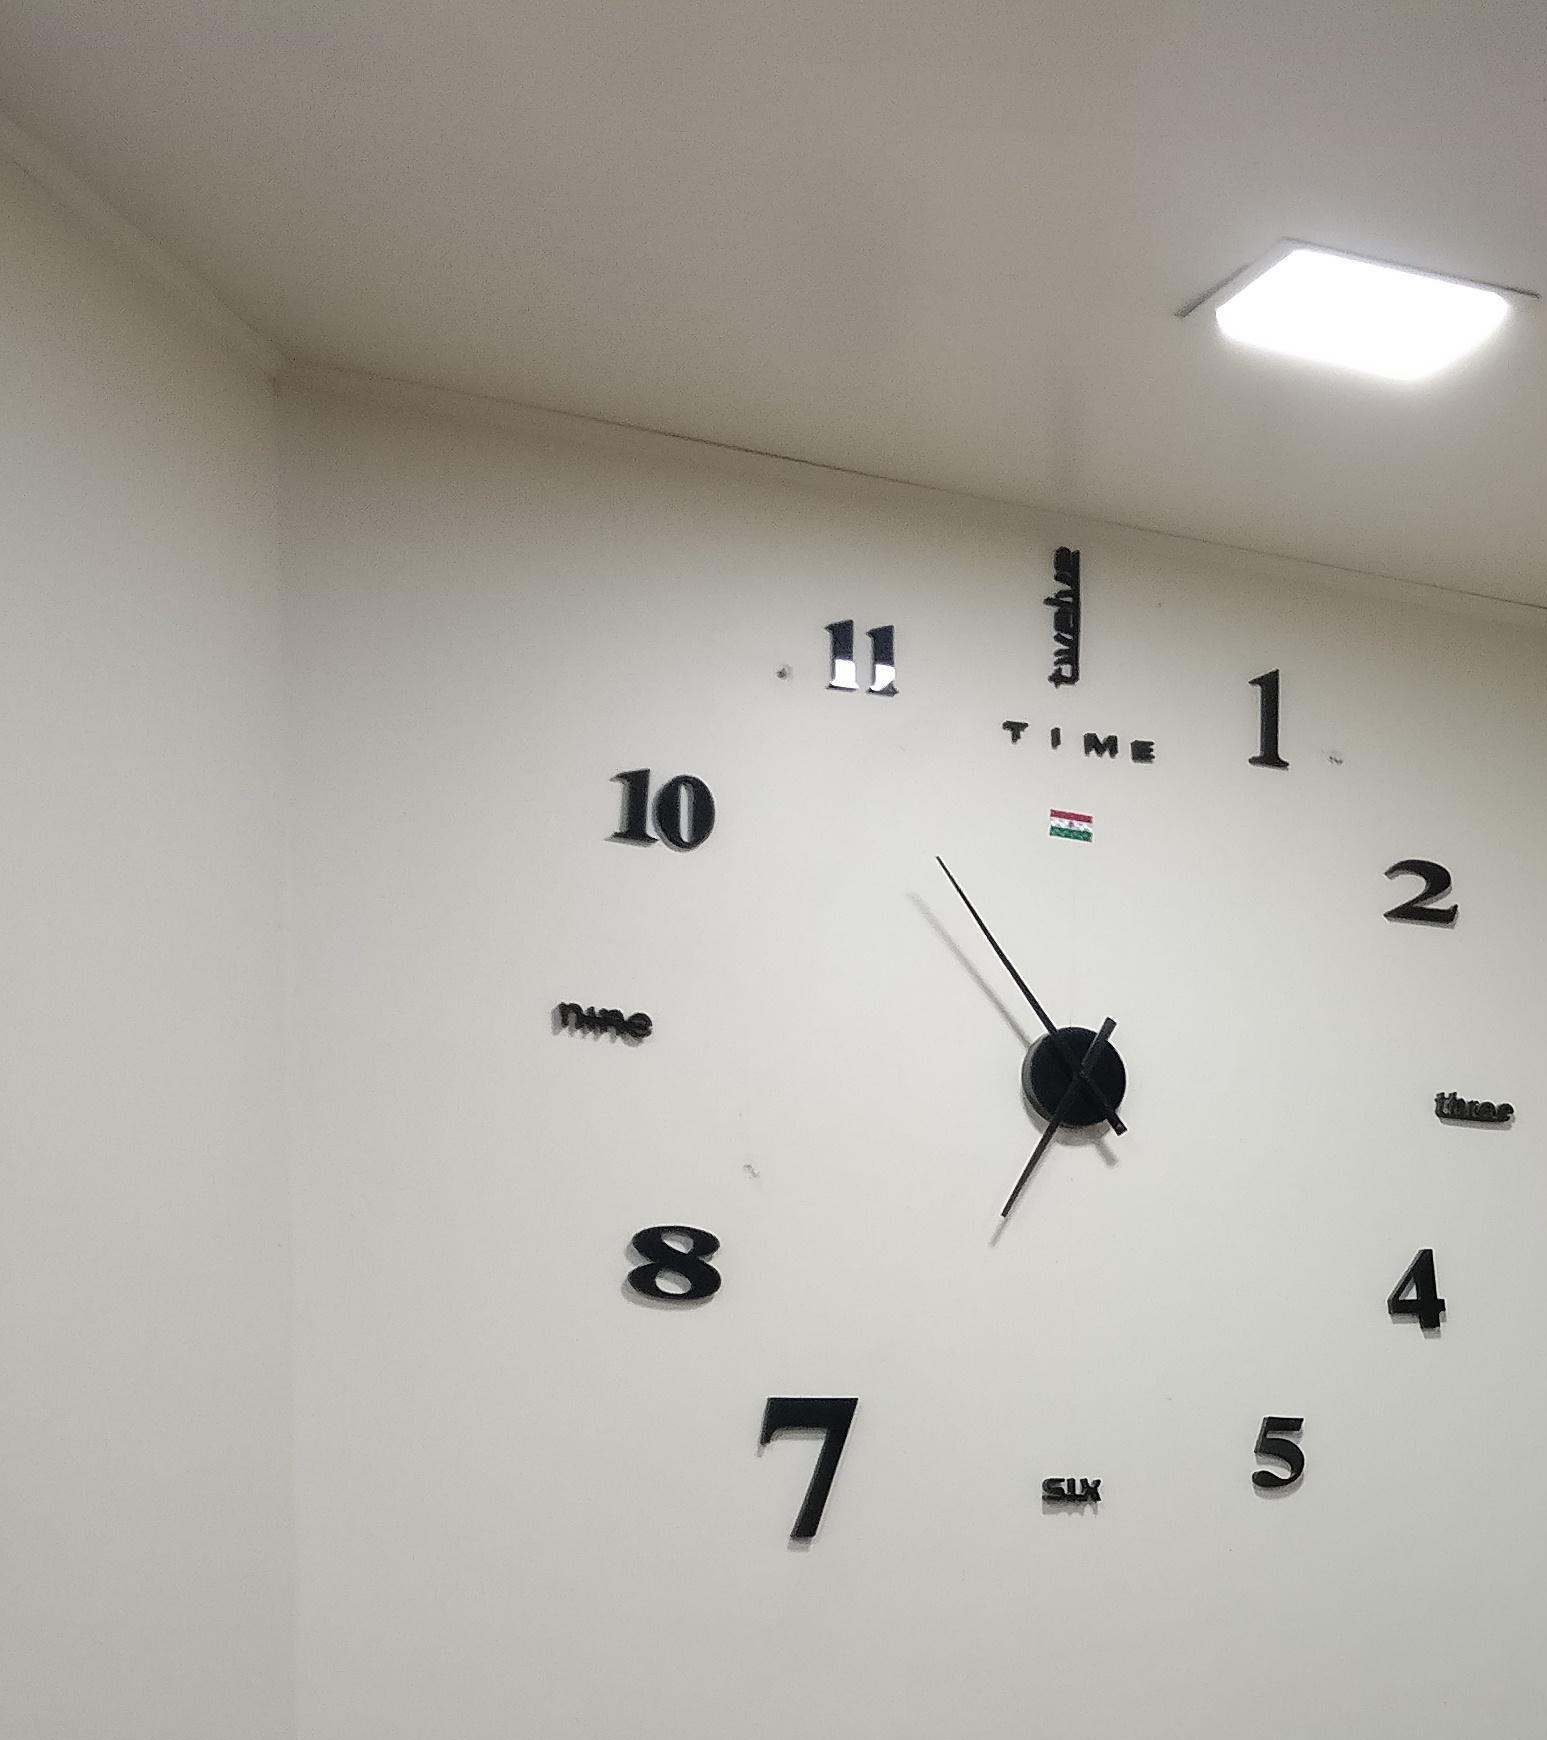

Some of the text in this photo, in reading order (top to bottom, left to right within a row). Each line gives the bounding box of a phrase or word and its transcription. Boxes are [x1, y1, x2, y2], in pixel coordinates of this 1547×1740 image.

[824, 620, 899, 697] 11
[1002, 720, 1156, 764] TIME
[1248, 669, 1290, 769] 1
[608, 768, 716, 851] 10
[1383, 859, 1459, 927] 2
[1434, 1091, 1515, 1123] three
[626, 1225, 722, 1302] 8
[1386, 1248, 1447, 1333] 4
[759, 1397, 859, 1544] 7
[1251, 1416, 1305, 1491] 5
